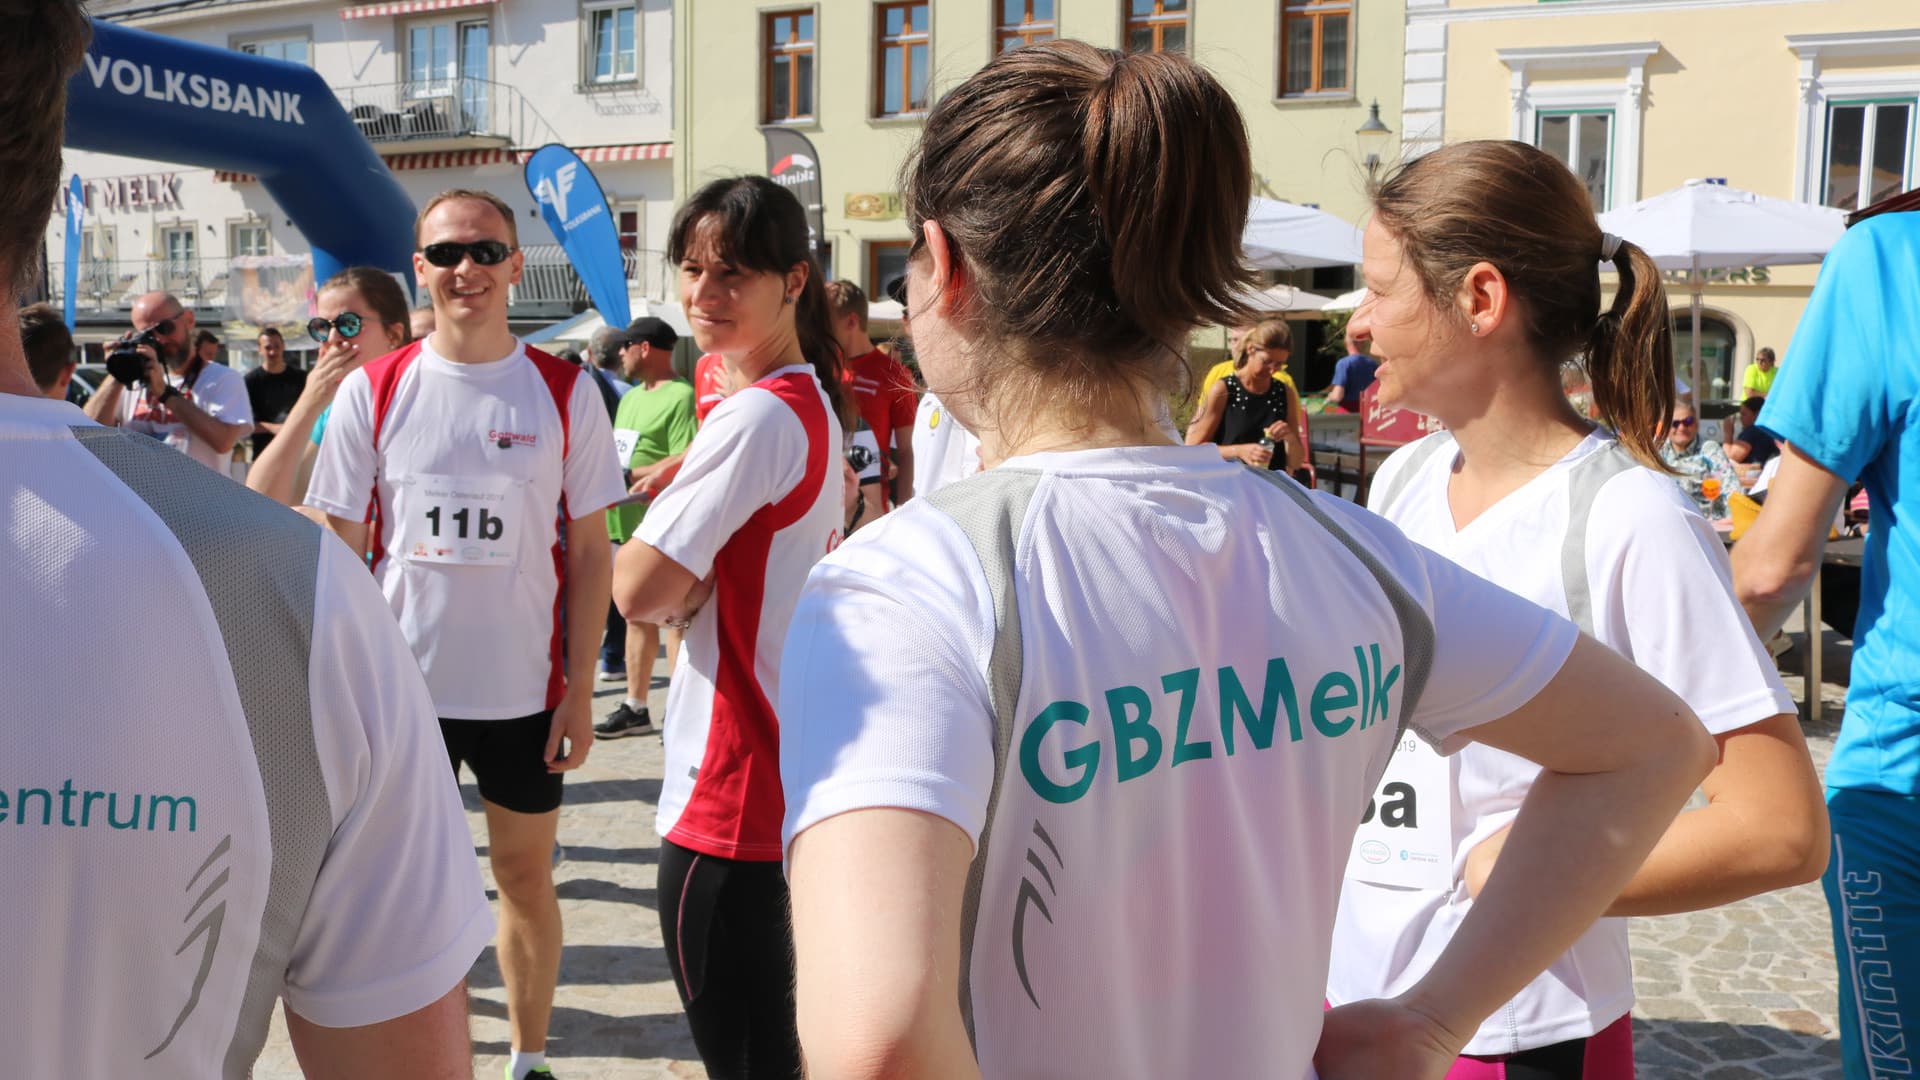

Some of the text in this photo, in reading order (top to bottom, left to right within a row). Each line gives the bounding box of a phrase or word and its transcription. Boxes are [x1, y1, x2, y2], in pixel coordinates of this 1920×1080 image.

[85, 53, 305, 125] VOLKSBANK
[102, 172, 177, 208] MELK
[425, 506, 504, 540] 11b
[0, 778, 197, 832] ntrum
[1842, 871, 1913, 1080] kinfit
